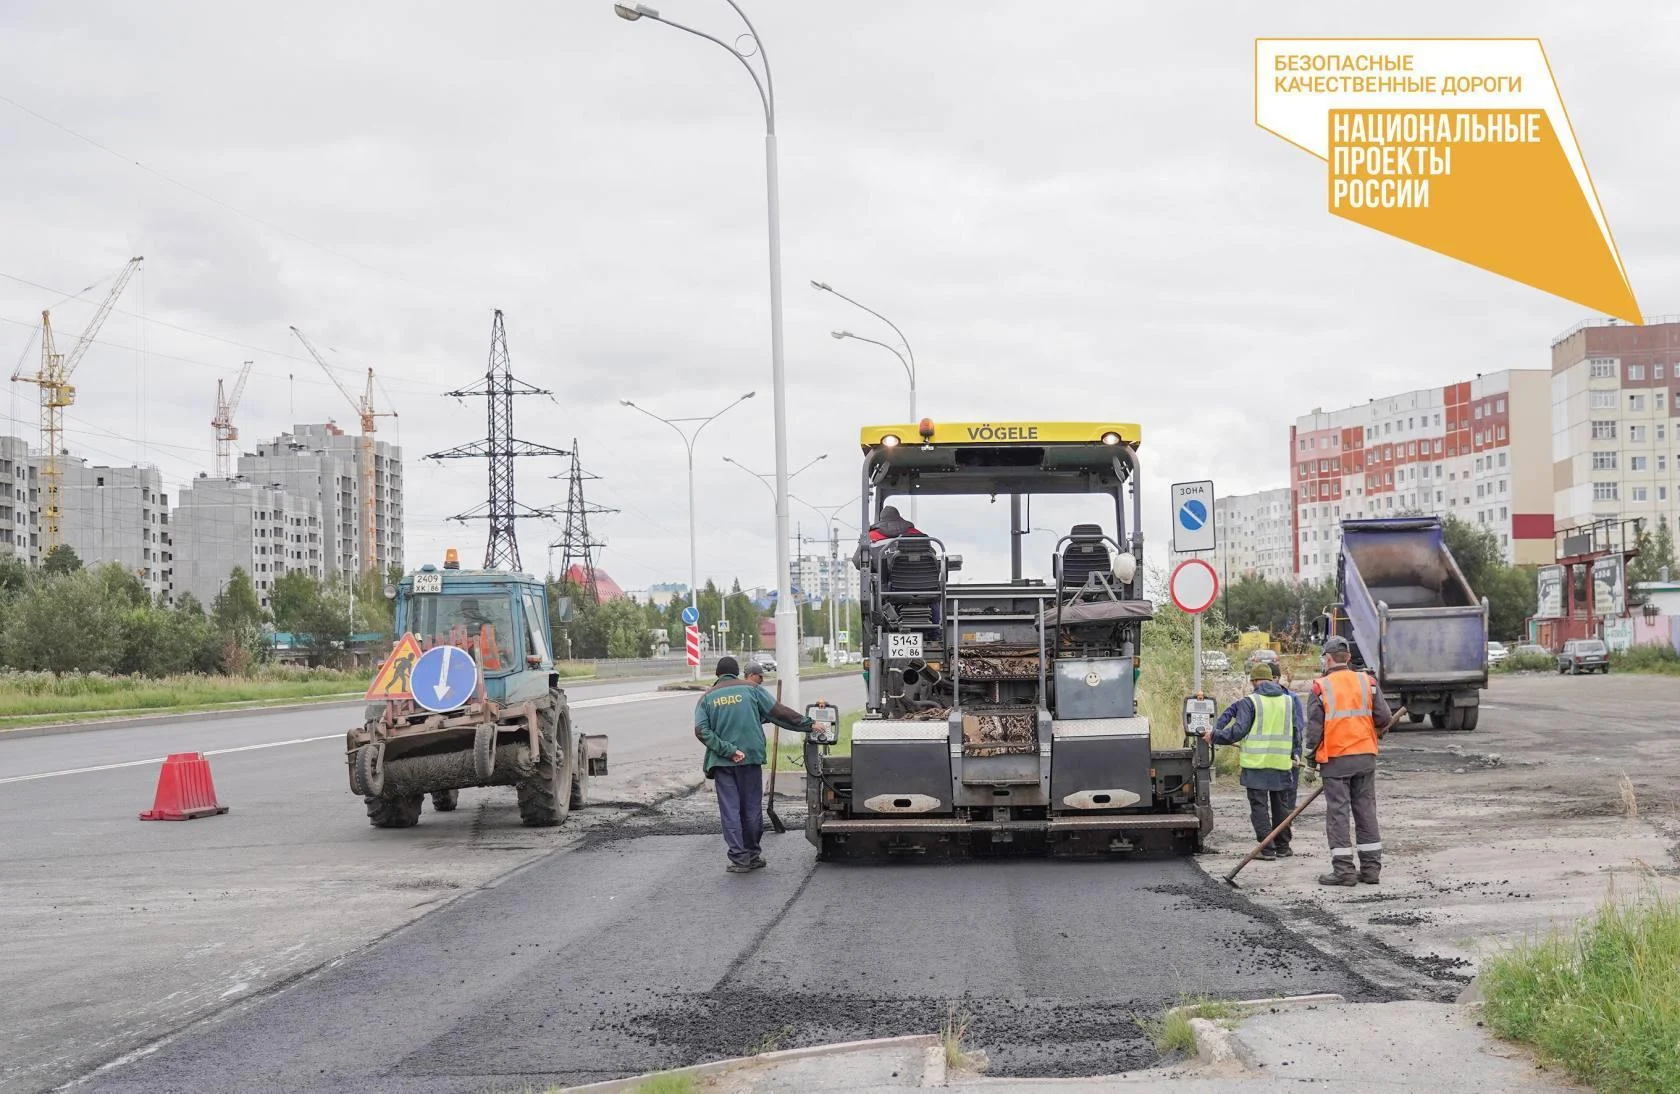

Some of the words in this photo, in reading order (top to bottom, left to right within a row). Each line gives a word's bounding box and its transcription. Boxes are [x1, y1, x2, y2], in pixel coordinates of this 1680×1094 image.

[967, 423, 1038, 441] VÖGELE
[1180, 487, 1204, 496] ЗОНА
[417, 575, 439, 583] 2409
[893, 635, 918, 646] 5143
[909, 648, 920, 657] 86
[712, 694, 743, 708] НВДС
